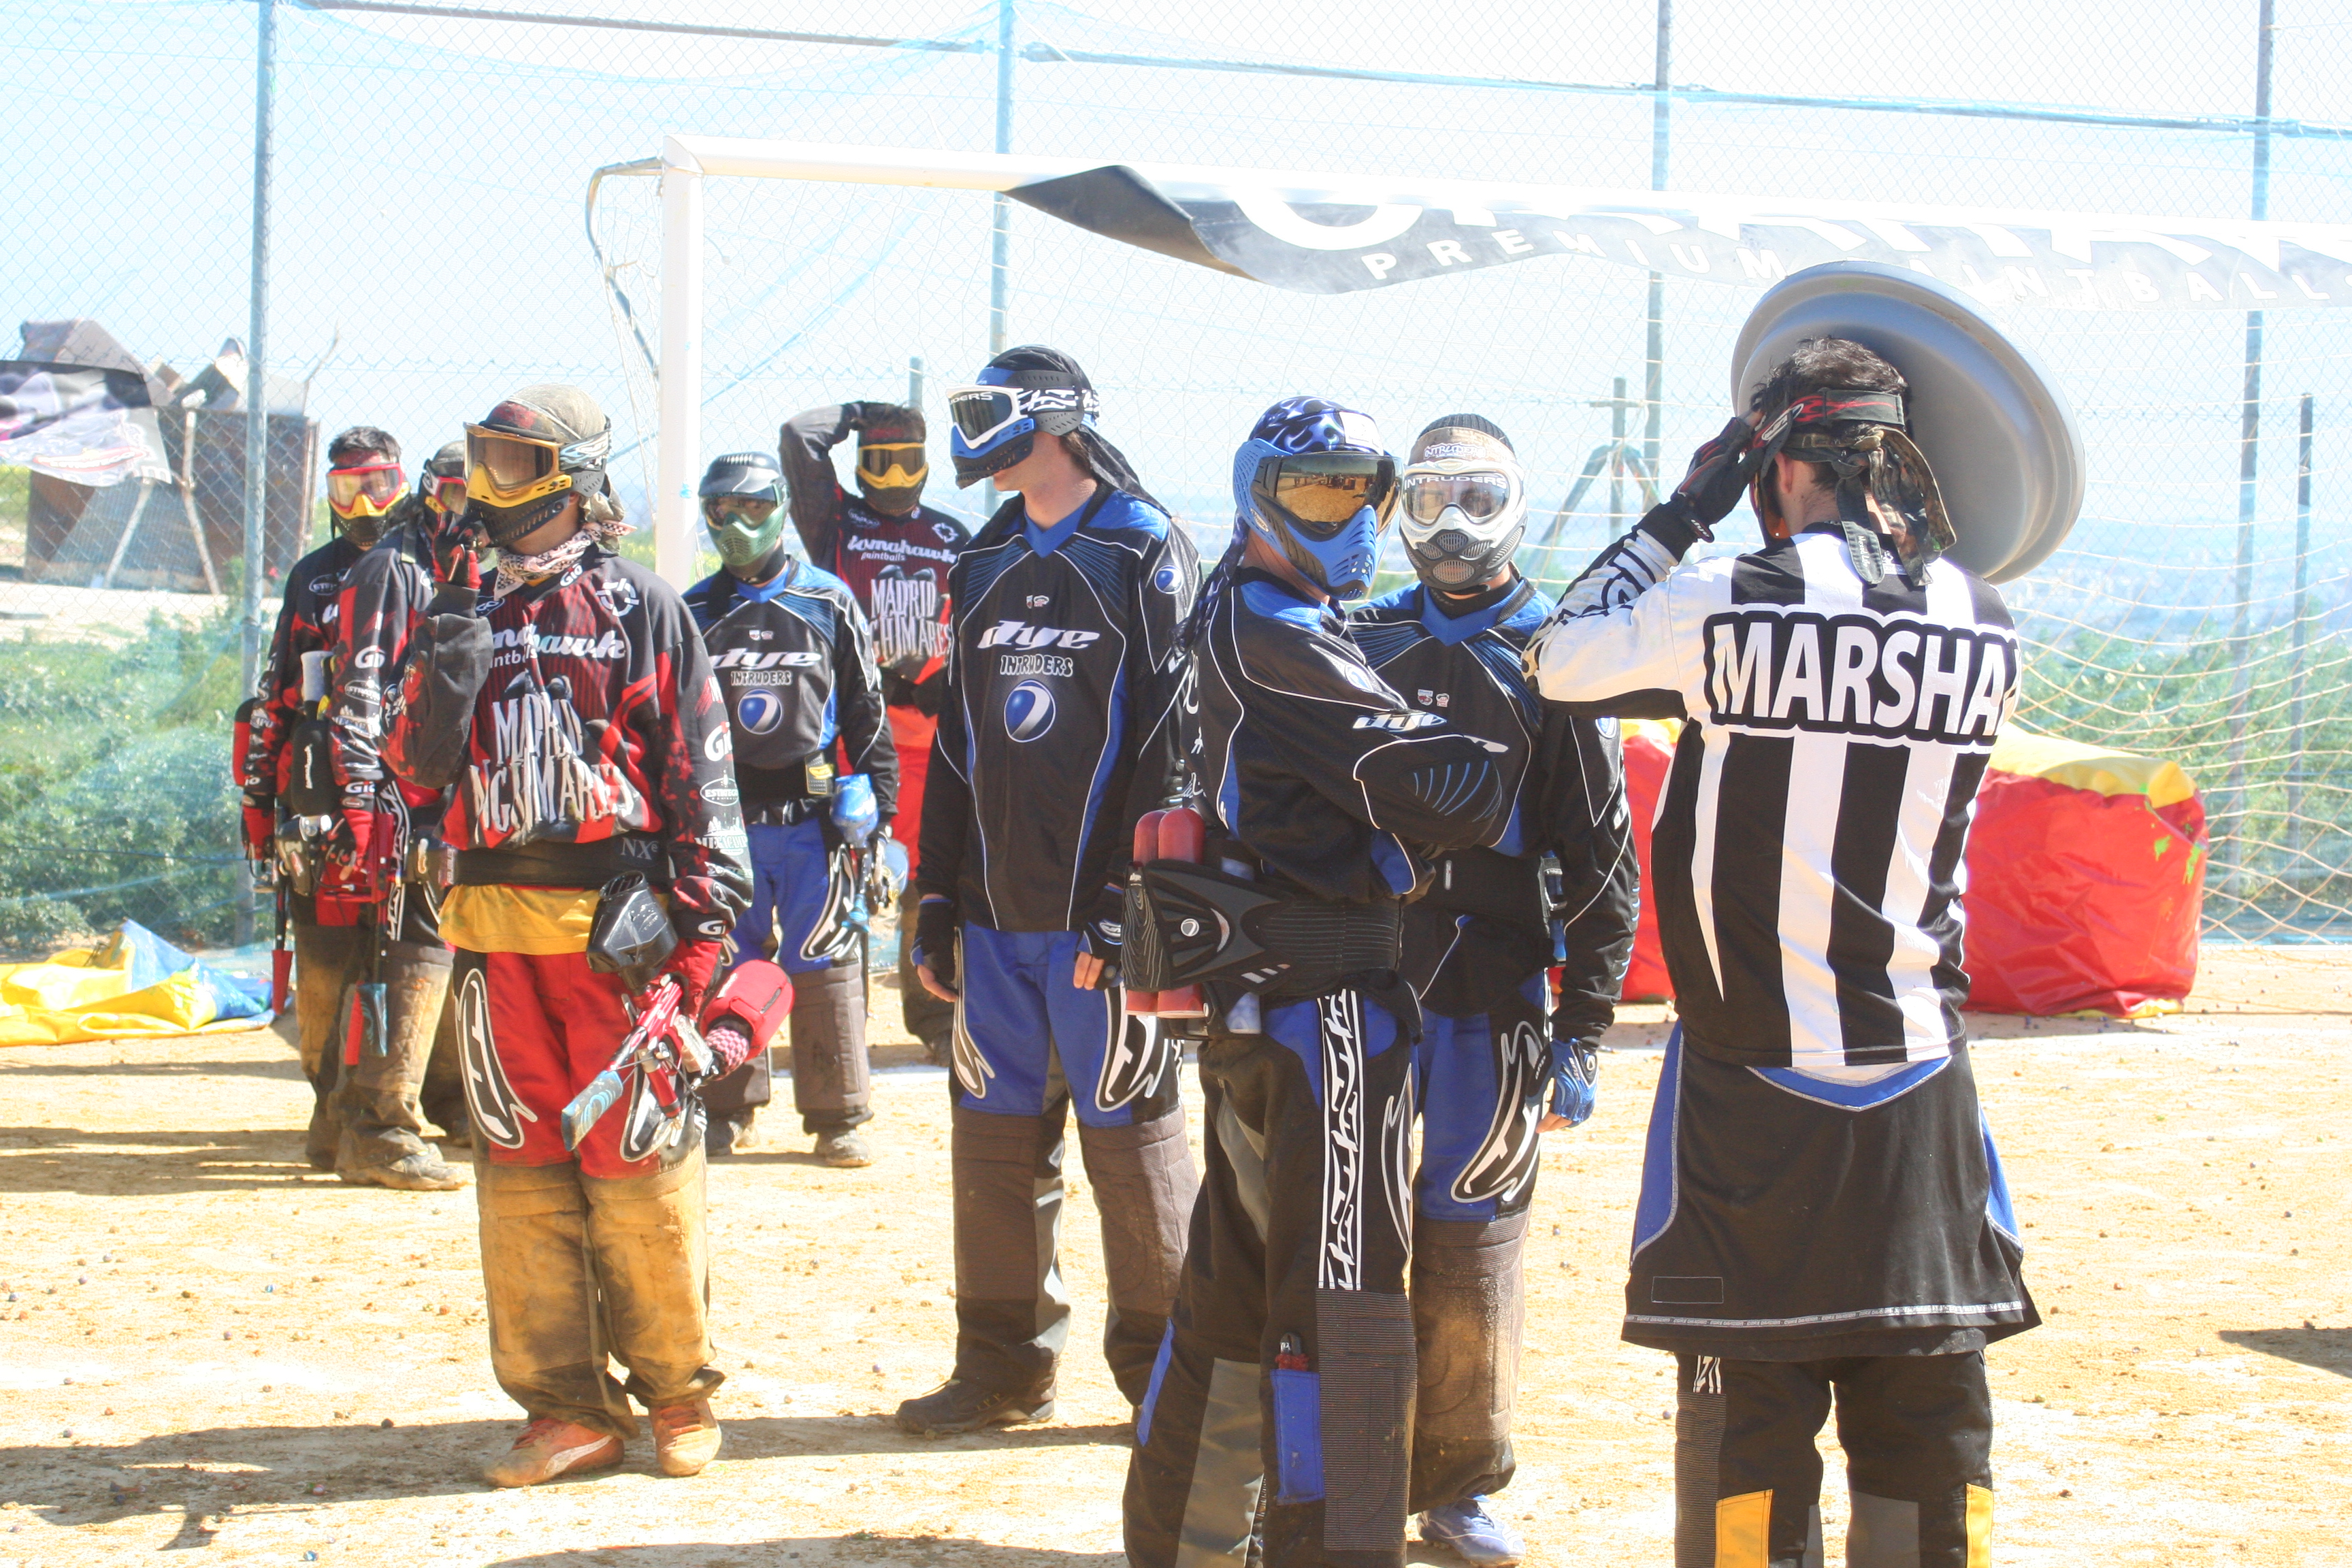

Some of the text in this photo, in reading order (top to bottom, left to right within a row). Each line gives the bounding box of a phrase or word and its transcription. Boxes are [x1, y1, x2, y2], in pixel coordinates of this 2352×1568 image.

[1361, 229, 1788, 280] PREMIUM
[1846, 256, 2352, 304] INTBALL
[847, 534, 958, 564] tomahawk
[860, 551, 906, 566] paintballs
[870, 577, 937, 619] MADRID
[869, 610, 952, 663] GHTMARES
[977, 620, 1100, 651] dye
[730, 670, 793, 687] INTRUDERS
[1000, 653, 1073, 677] INTRUDERS
[1712, 621, 2019, 737] MARSHA
